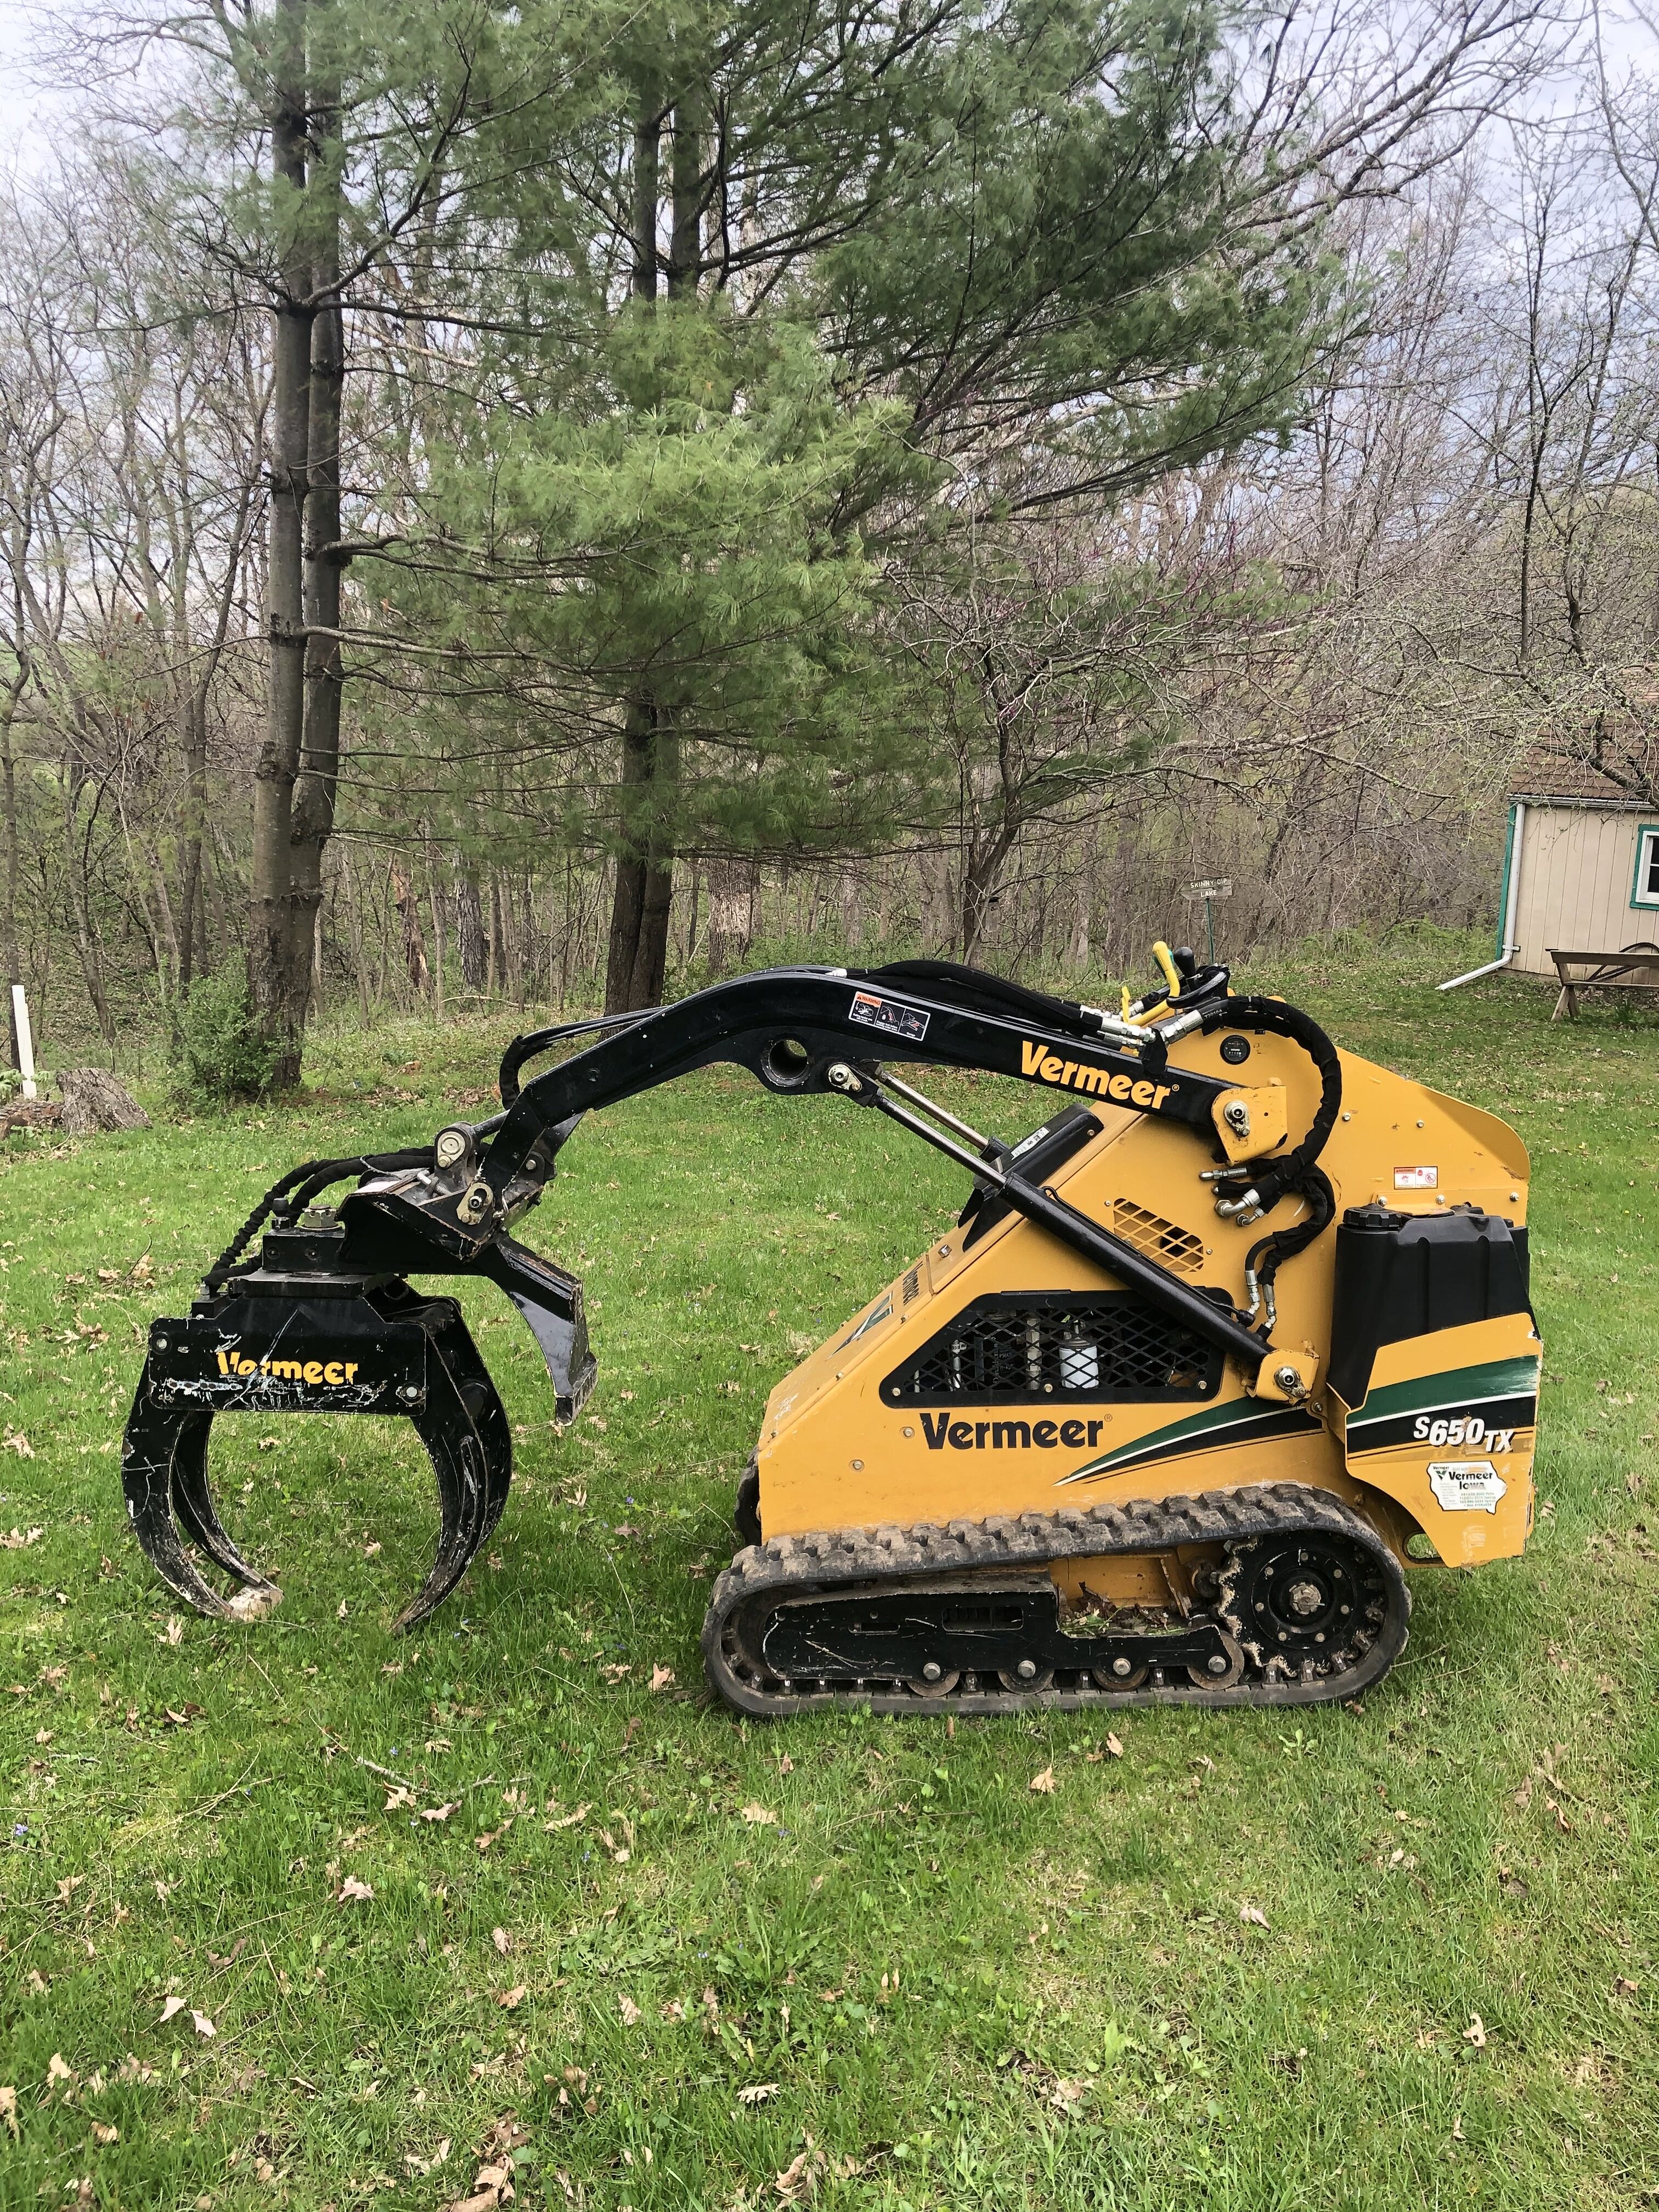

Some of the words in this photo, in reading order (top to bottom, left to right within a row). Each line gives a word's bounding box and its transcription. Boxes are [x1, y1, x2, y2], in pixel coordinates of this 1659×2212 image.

[1190, 879, 1214, 888] SKINNY
[1200, 889, 1217, 898] LAKE
[1022, 1040, 1171, 1110] Vermeer
[217, 1351, 358, 1385] Vermeer
[919, 1412, 1104, 1450] Vermeer
[1448, 1471, 1493, 1480] Vermeer
[1459, 1481, 1485, 1490] Iowa
